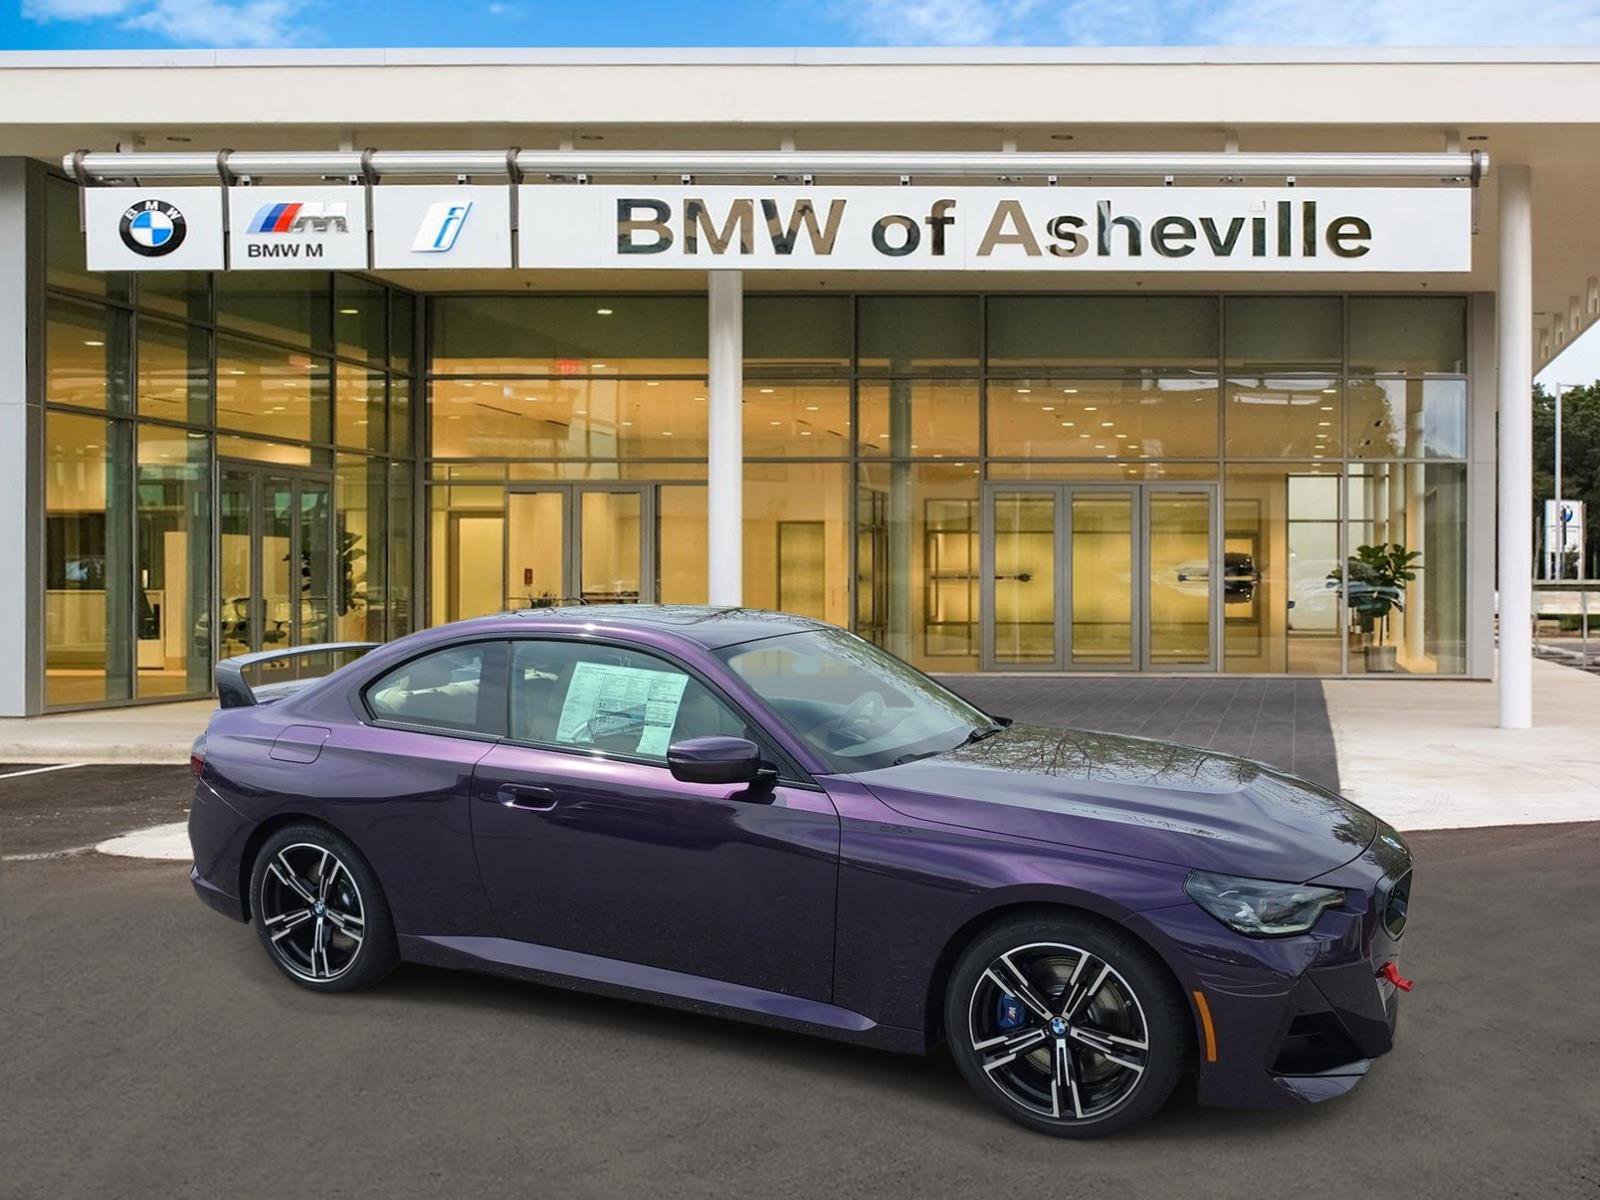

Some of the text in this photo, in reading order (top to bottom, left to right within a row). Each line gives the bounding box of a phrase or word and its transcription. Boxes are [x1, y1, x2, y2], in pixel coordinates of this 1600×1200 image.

[616, 198, 1374, 257] BMW of Asheville
[248, 244, 323, 258] BMW M
